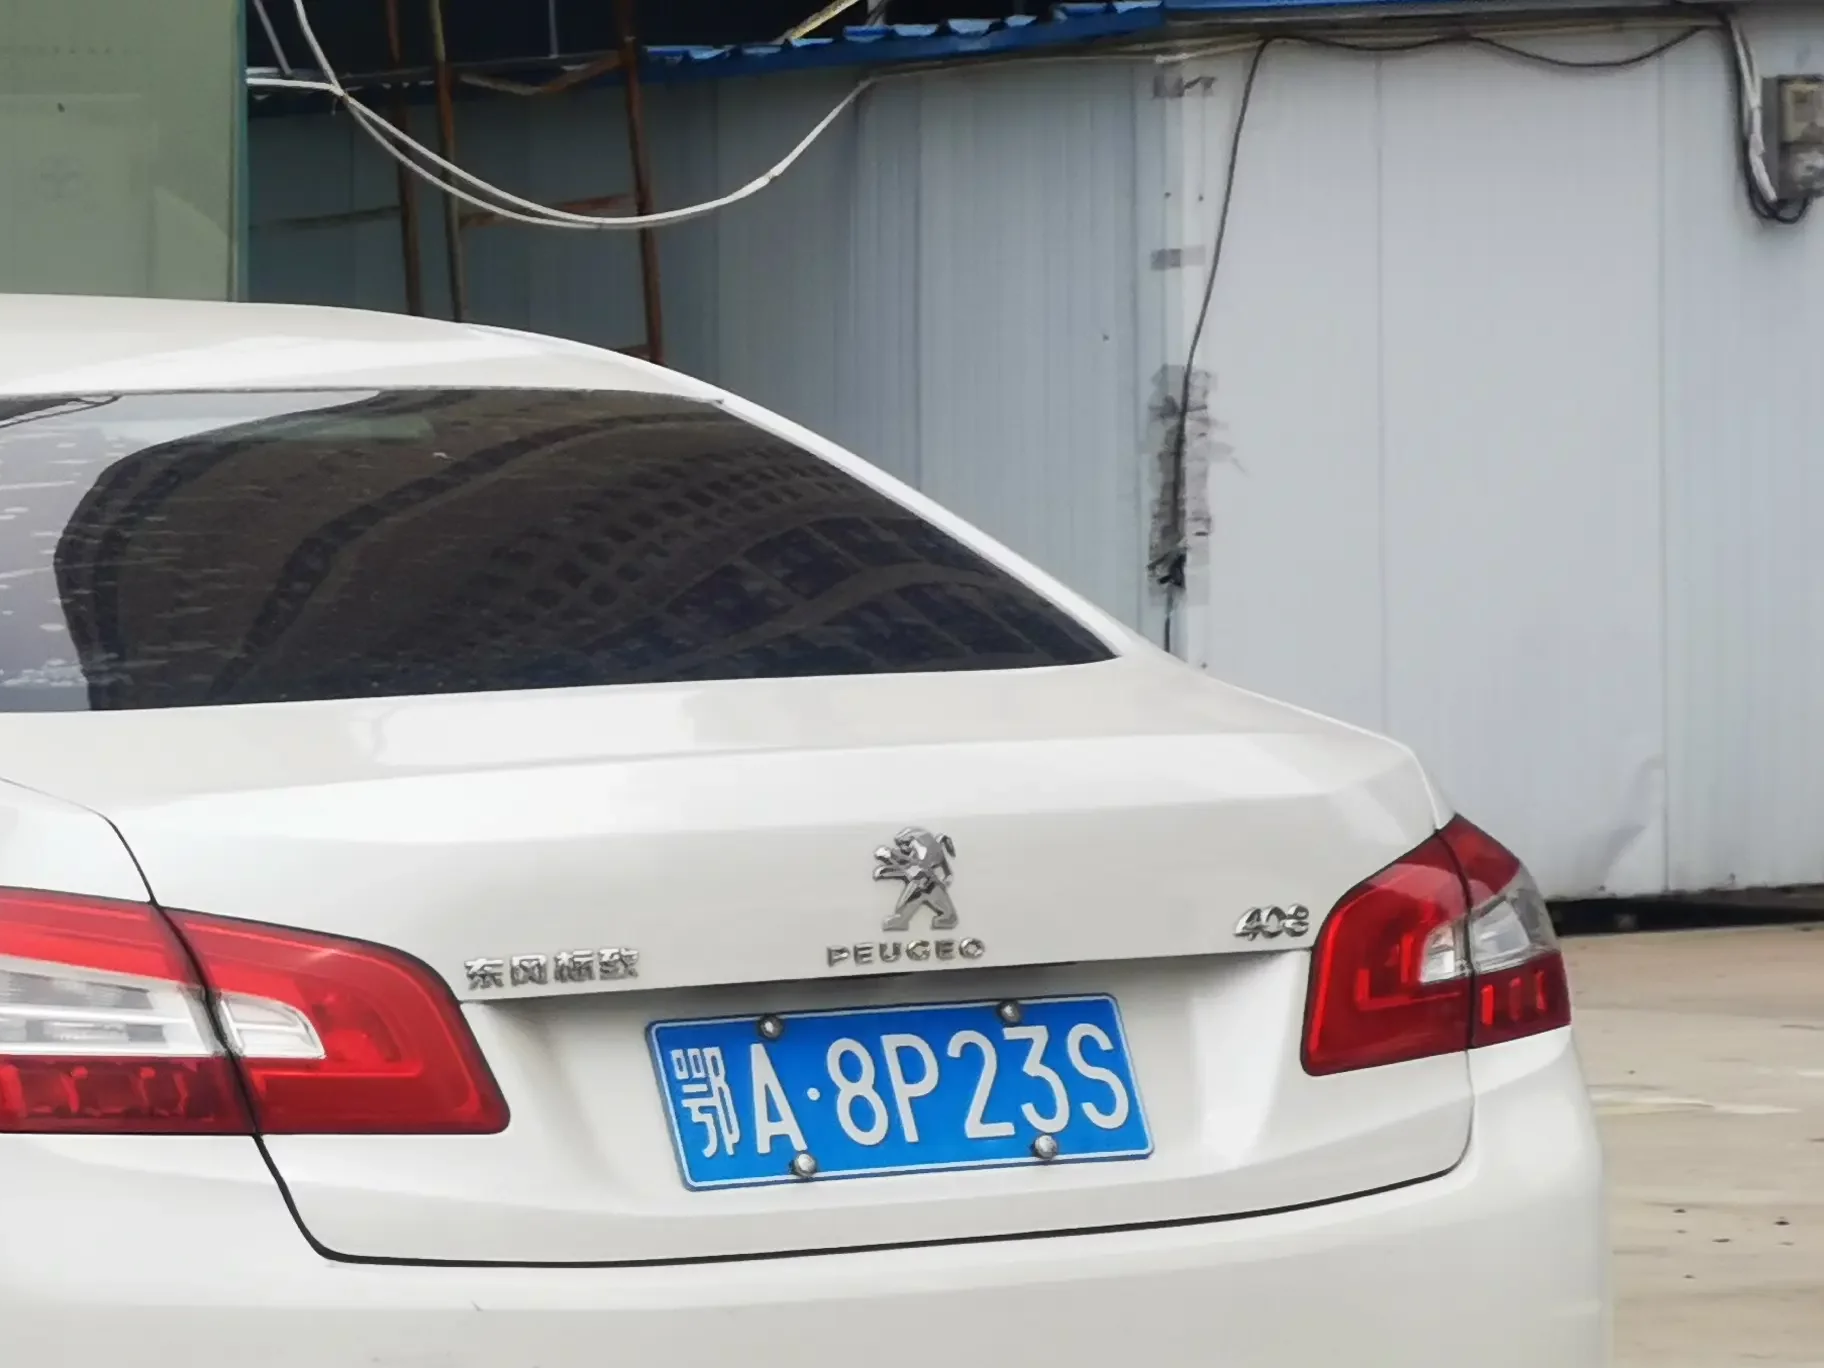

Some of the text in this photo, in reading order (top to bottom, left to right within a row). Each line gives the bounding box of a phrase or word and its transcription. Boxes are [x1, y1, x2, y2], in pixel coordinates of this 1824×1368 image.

[1233, 903, 1310, 941] 408
[464, 948, 639, 990] 东风标致
[826, 937, 985, 967] PEUGEO
